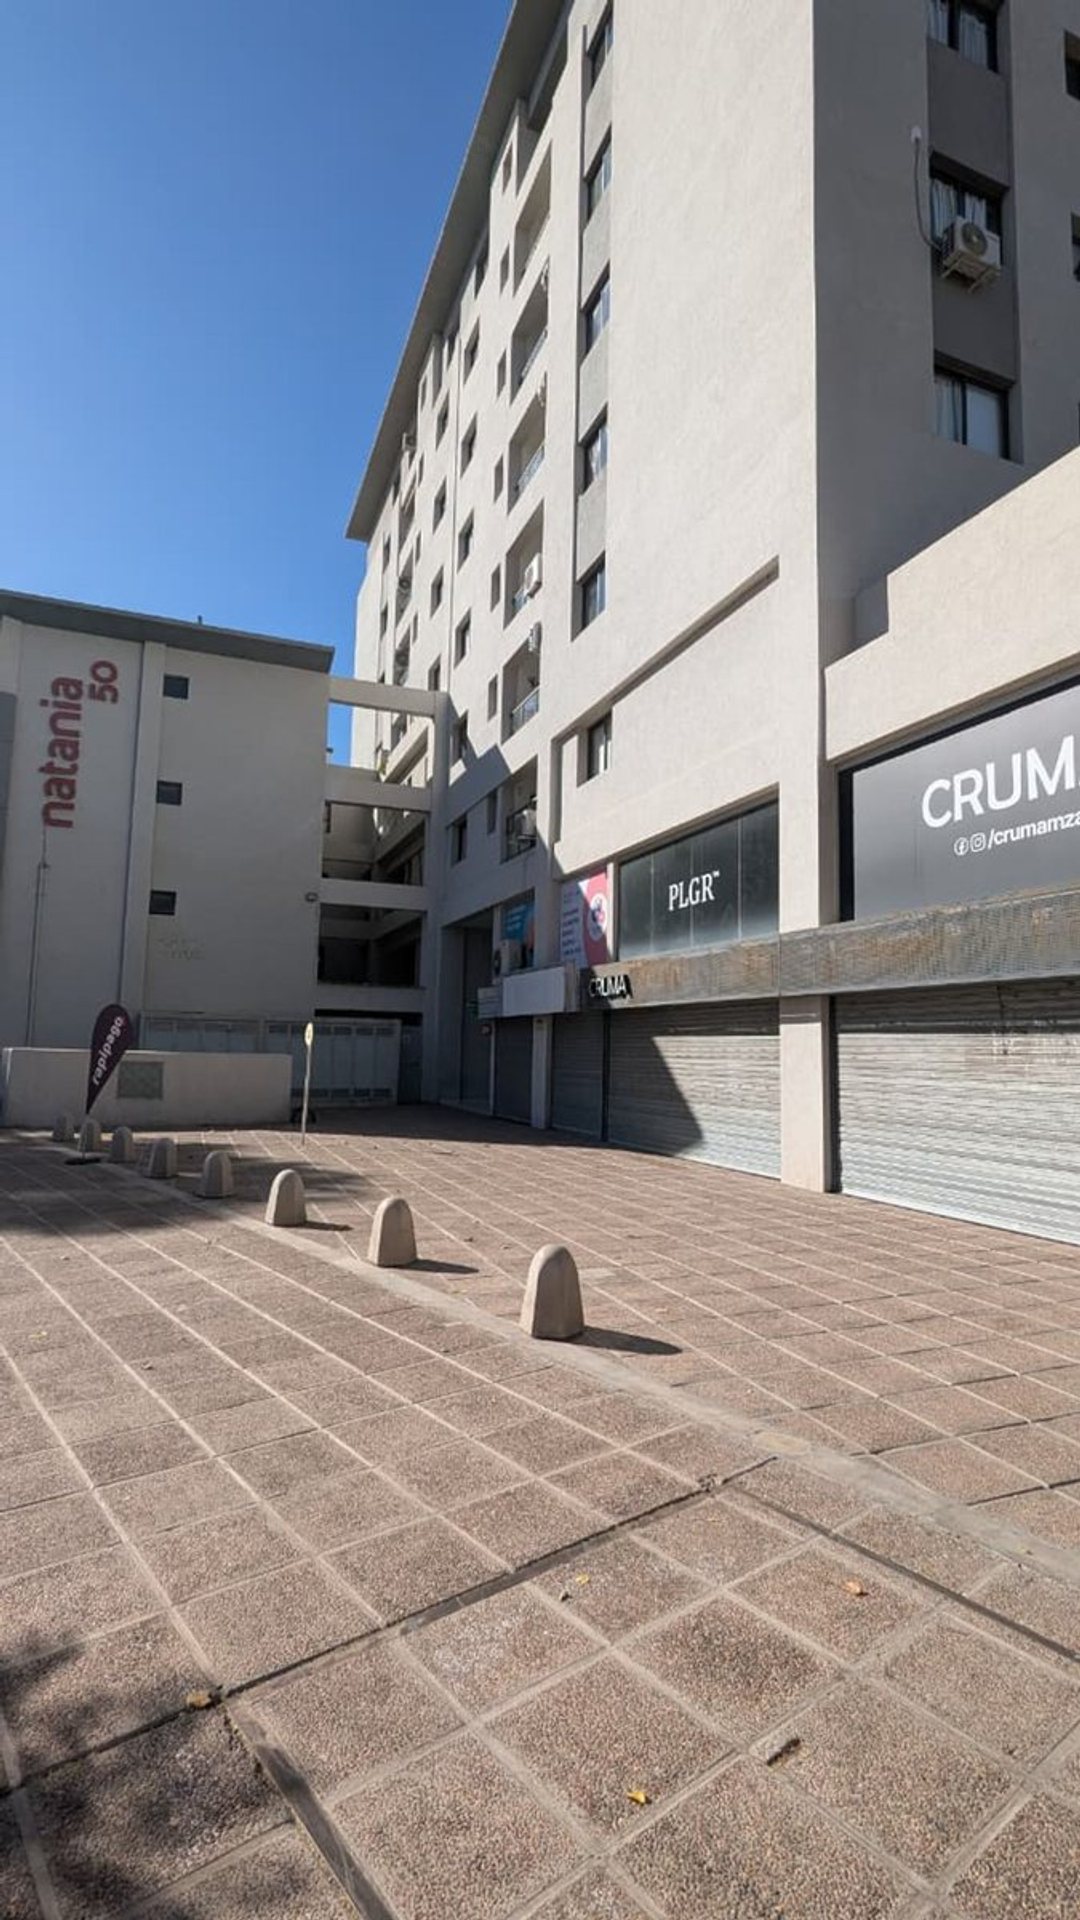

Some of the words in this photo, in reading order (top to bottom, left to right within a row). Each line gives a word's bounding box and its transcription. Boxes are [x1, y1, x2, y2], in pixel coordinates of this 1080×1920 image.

[89, 660, 118, 704] 50
[39, 676, 83, 828] natania
[922, 735, 1080, 828] CRUM
[589, 975, 627, 997] CRUMA
[93, 1016, 123, 1086] rapipago
